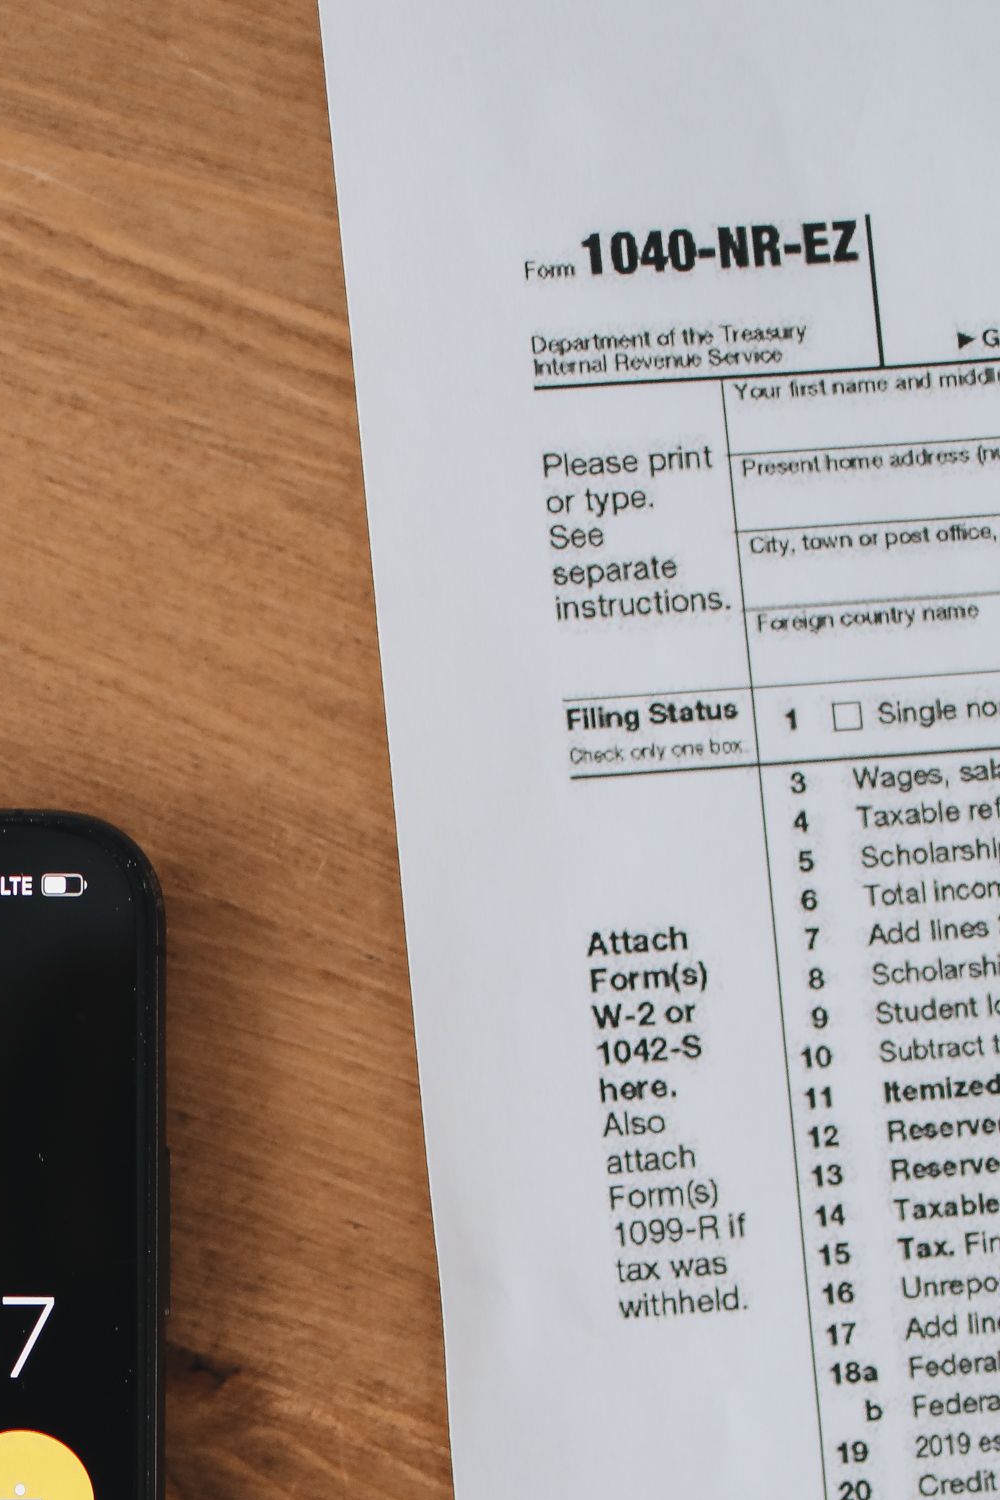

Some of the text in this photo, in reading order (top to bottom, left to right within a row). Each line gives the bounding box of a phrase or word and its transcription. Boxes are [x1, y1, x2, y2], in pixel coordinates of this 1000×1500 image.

[524, 219, 860, 281] Form 1040-NR-EZ
[531, 324, 807, 356] Department of the Treasury
[533, 348, 783, 377] Internal Revenue Service
[733, 370, 932, 400] Your first name and
[542, 445, 713, 478] Please print
[742, 448, 970, 478] Present home address
[546, 488, 654, 518] or type.
[549, 524, 604, 550] See
[749, 523, 997, 557] City, town or post office,
[552, 555, 678, 589] separate
[555, 589, 731, 622] instructions.
[757, 604, 979, 634] Foreign country name
[566, 700, 739, 732] Filing Status
[784, 698, 957, 731] 1 Single
[570, 747, 624, 765] Check
[630, 743, 665, 761] only
[671, 744, 704, 758] one
[790, 766, 949, 794] 3 Wages,
[793, 800, 961, 834] 4 Taxable
[0, 876, 33, 896] LTE
[800, 881, 926, 912] 6 Total
[586, 926, 688, 958] Attach
[804, 918, 990, 951] 7 Add lines
[590, 960, 708, 994] Form(s)
[590, 1001, 696, 1030] W-2 or
[810, 997, 979, 1030] 9 Student
[596, 1033, 702, 1067] 1042-S
[800, 1035, 985, 1069] 10 Subtract
[599, 1077, 677, 1104] here.
[804, 1072, 1000, 1110] 11 Itemized
[602, 1111, 666, 1138] Also
[607, 1144, 696, 1175] attach
[609, 1178, 718, 1211] Form(s)
[815, 1192, 1000, 1228] 14 Taxable
[615, 1212, 746, 1247] 1099-R if
[818, 1236, 955, 1267] 15 Tax.
[616, 1256, 728, 1283] tax was
[618, 1284, 748, 1319] withheld.
[826, 1314, 958, 1347] 17 Add
[829, 1361, 879, 1386] 18a
[836, 1431, 971, 1464] 19 2019
[918, 1469, 998, 1497] Credit
